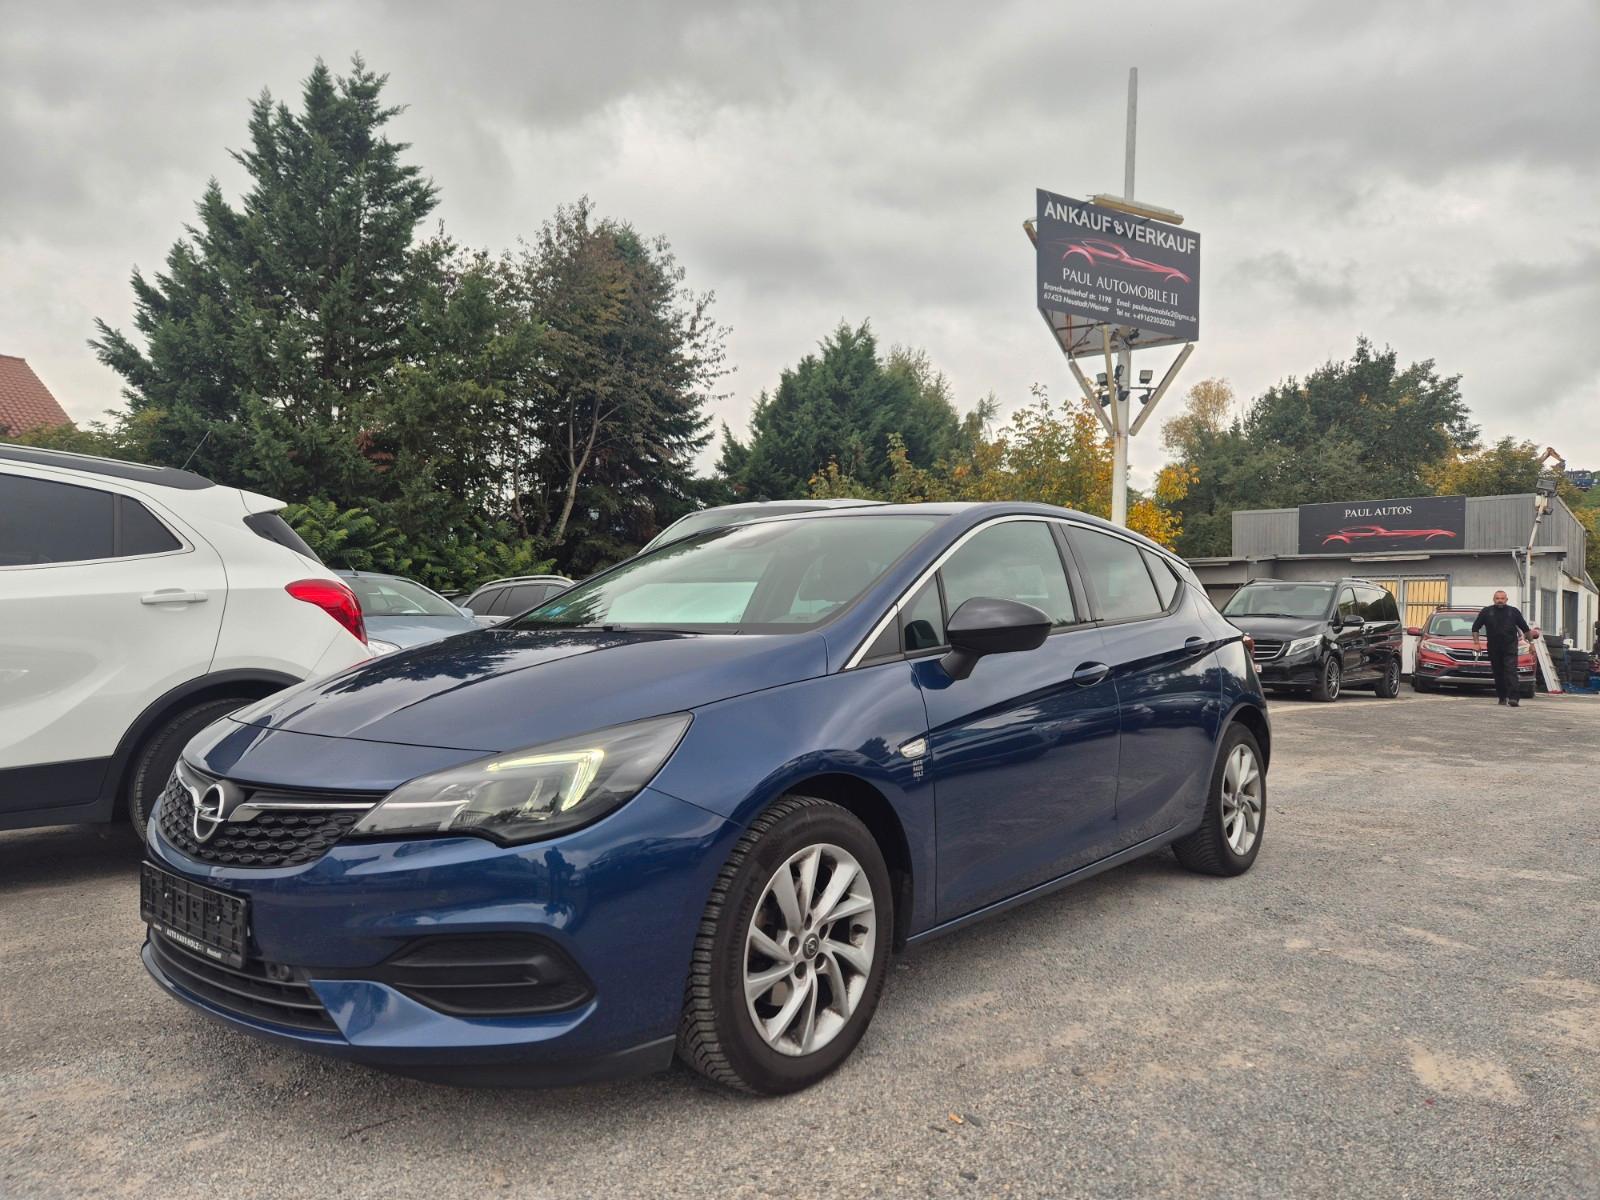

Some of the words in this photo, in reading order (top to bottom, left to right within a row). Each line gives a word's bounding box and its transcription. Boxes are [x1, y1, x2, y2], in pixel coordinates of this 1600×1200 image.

[1063, 268, 1092, 286] PAUL
[1096, 276, 1168, 303] AUTOMOBILE
[1170, 293, 1179, 306] II
[1345, 508, 1372, 518] PAUL
[1374, 505, 1413, 516] AUTOS
